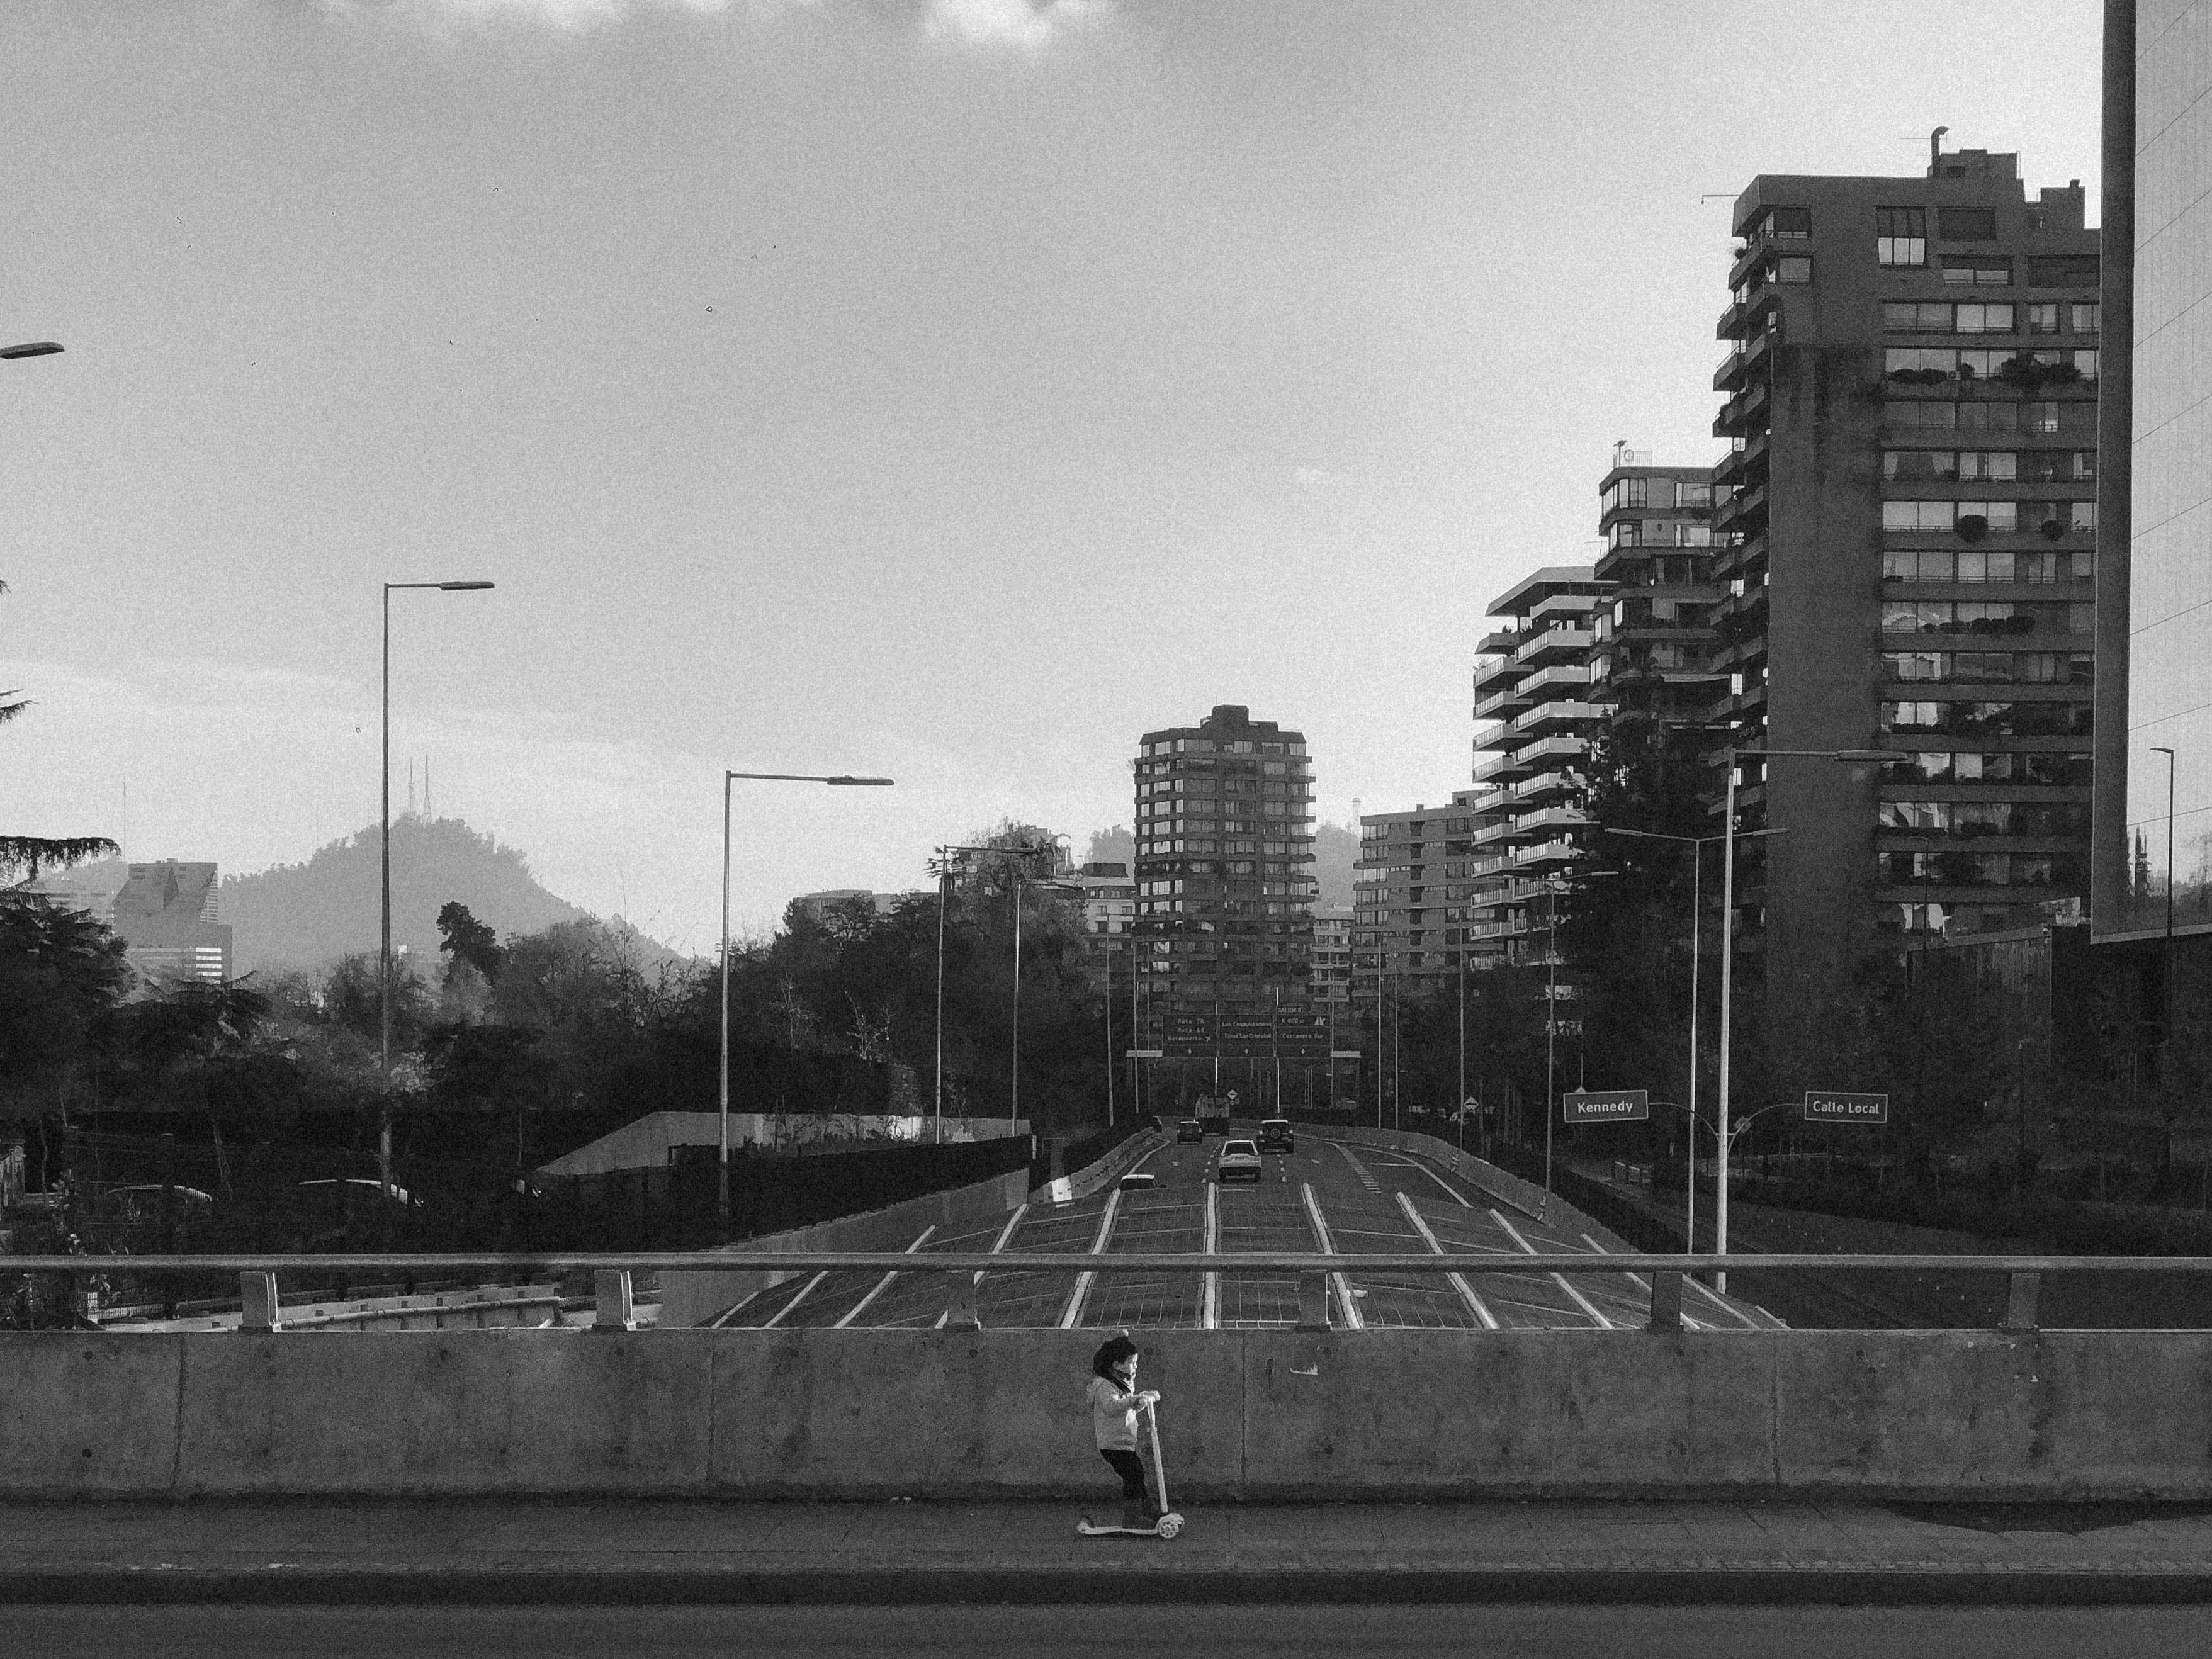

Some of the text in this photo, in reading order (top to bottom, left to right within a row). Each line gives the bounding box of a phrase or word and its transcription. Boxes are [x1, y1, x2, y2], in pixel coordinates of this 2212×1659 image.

[1577, 1099, 1633, 1113] Kennedy
[1813, 1101, 1880, 1114] Calle Local
